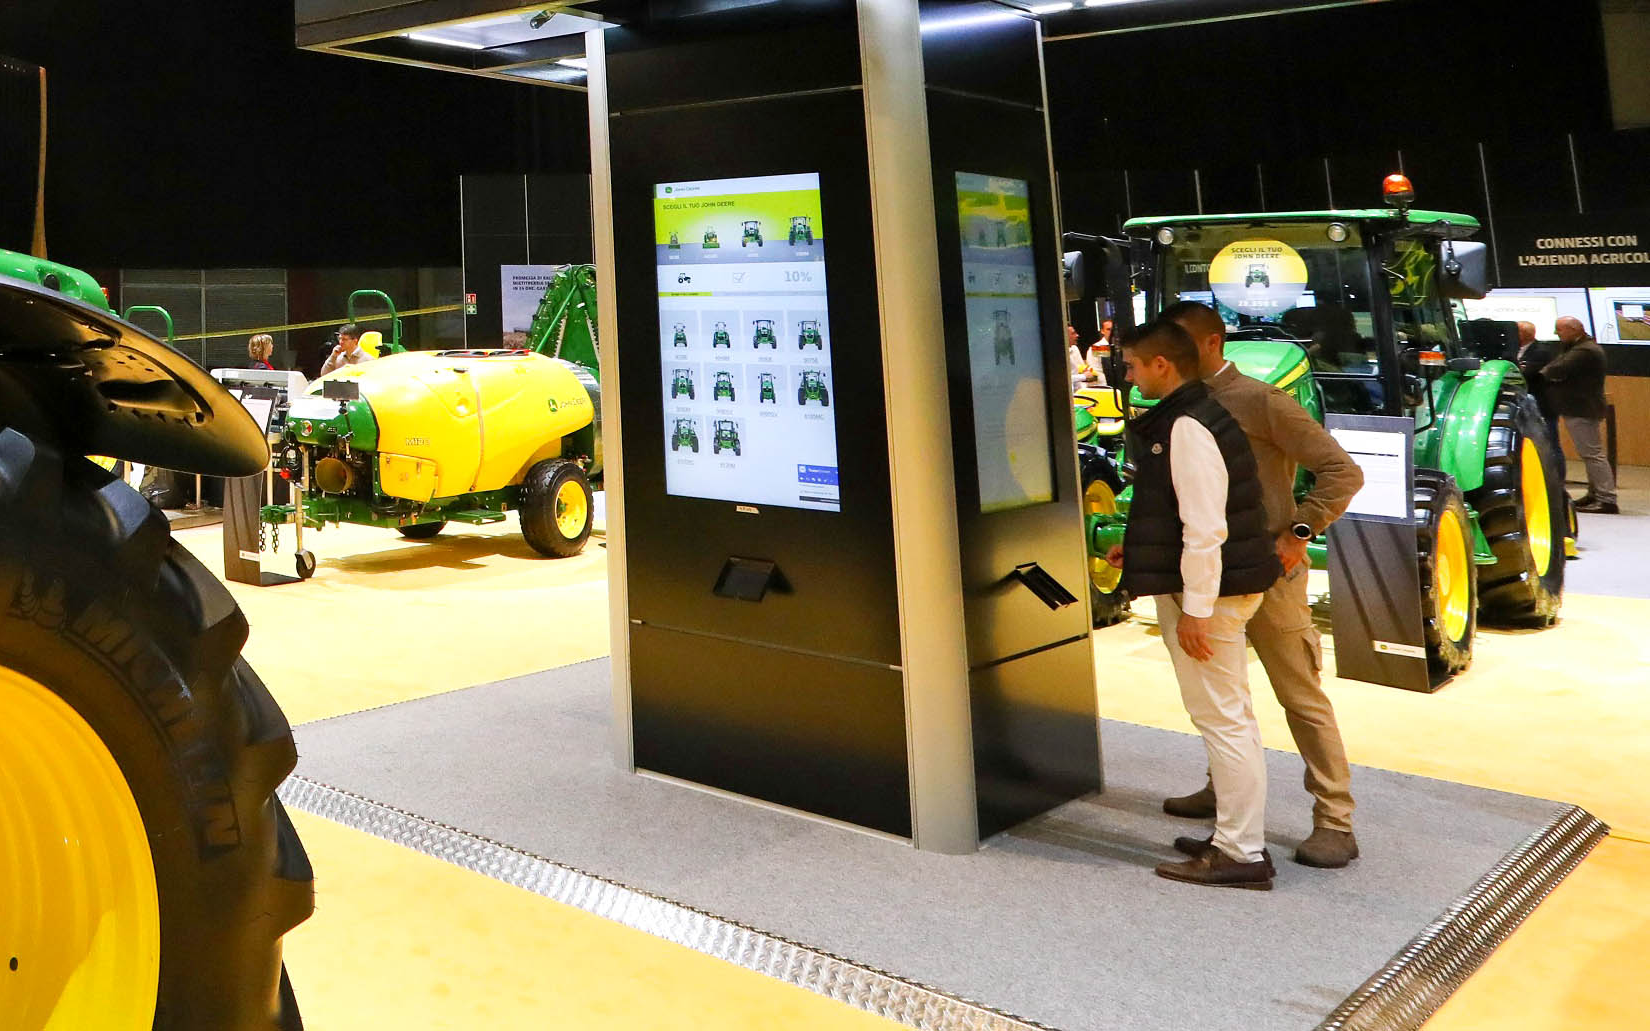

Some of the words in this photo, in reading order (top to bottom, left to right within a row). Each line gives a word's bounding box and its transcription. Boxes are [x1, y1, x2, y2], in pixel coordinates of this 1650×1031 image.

[1535, 236, 1603, 249] CONNESSI
[1606, 235, 1638, 247] CON
[1518, 254, 1589, 267] L'AZIENDA
[784, 270, 812, 282] 10%
